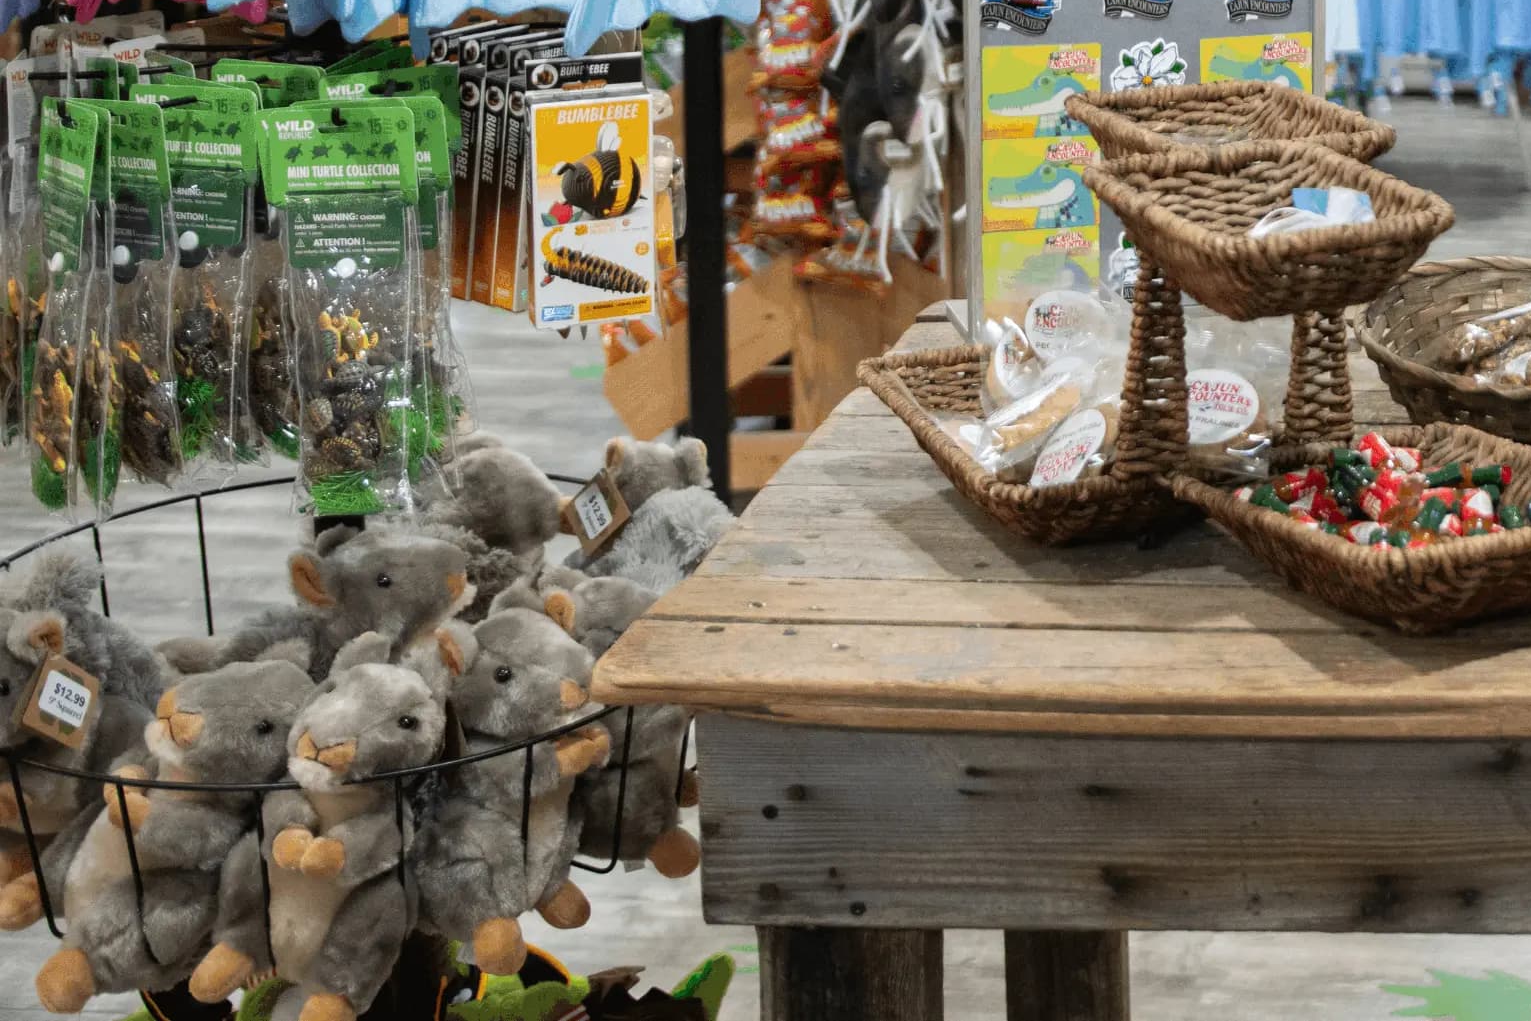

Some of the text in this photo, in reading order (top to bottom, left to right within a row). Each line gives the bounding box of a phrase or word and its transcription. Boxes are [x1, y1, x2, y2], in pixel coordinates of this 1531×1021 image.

[1229, 0, 1250, 13] CAJUN
[984, 4, 1048, 30] CAJUN ENCOUNTERS
[113, 47, 141, 61] WILD
[327, 84, 366, 95] WILD
[216, 98, 228, 114] 15
[129, 111, 141, 123] 15
[556, 103, 639, 125] BUMBLEBEE
[275, 120, 315, 132] WILD
[369, 118, 382, 135] 15
[278, 131, 313, 140] REPUBLIC
[194, 143, 242, 156] COLLECTION
[481, 114, 497, 184] BUMBLEBEE
[504, 118, 520, 190] BUMBLEBEE
[118, 157, 157, 170] COLLECTION
[287, 164, 400, 179] MINI TURTLE COLLECTION
[313, 213, 359, 222] WARNING:
[313, 238, 361, 247] ATTENTION
[1191, 380, 1240, 393] CAJUN
[588, 494, 607, 526] $12.99
[54, 682, 86, 707] $12.99
